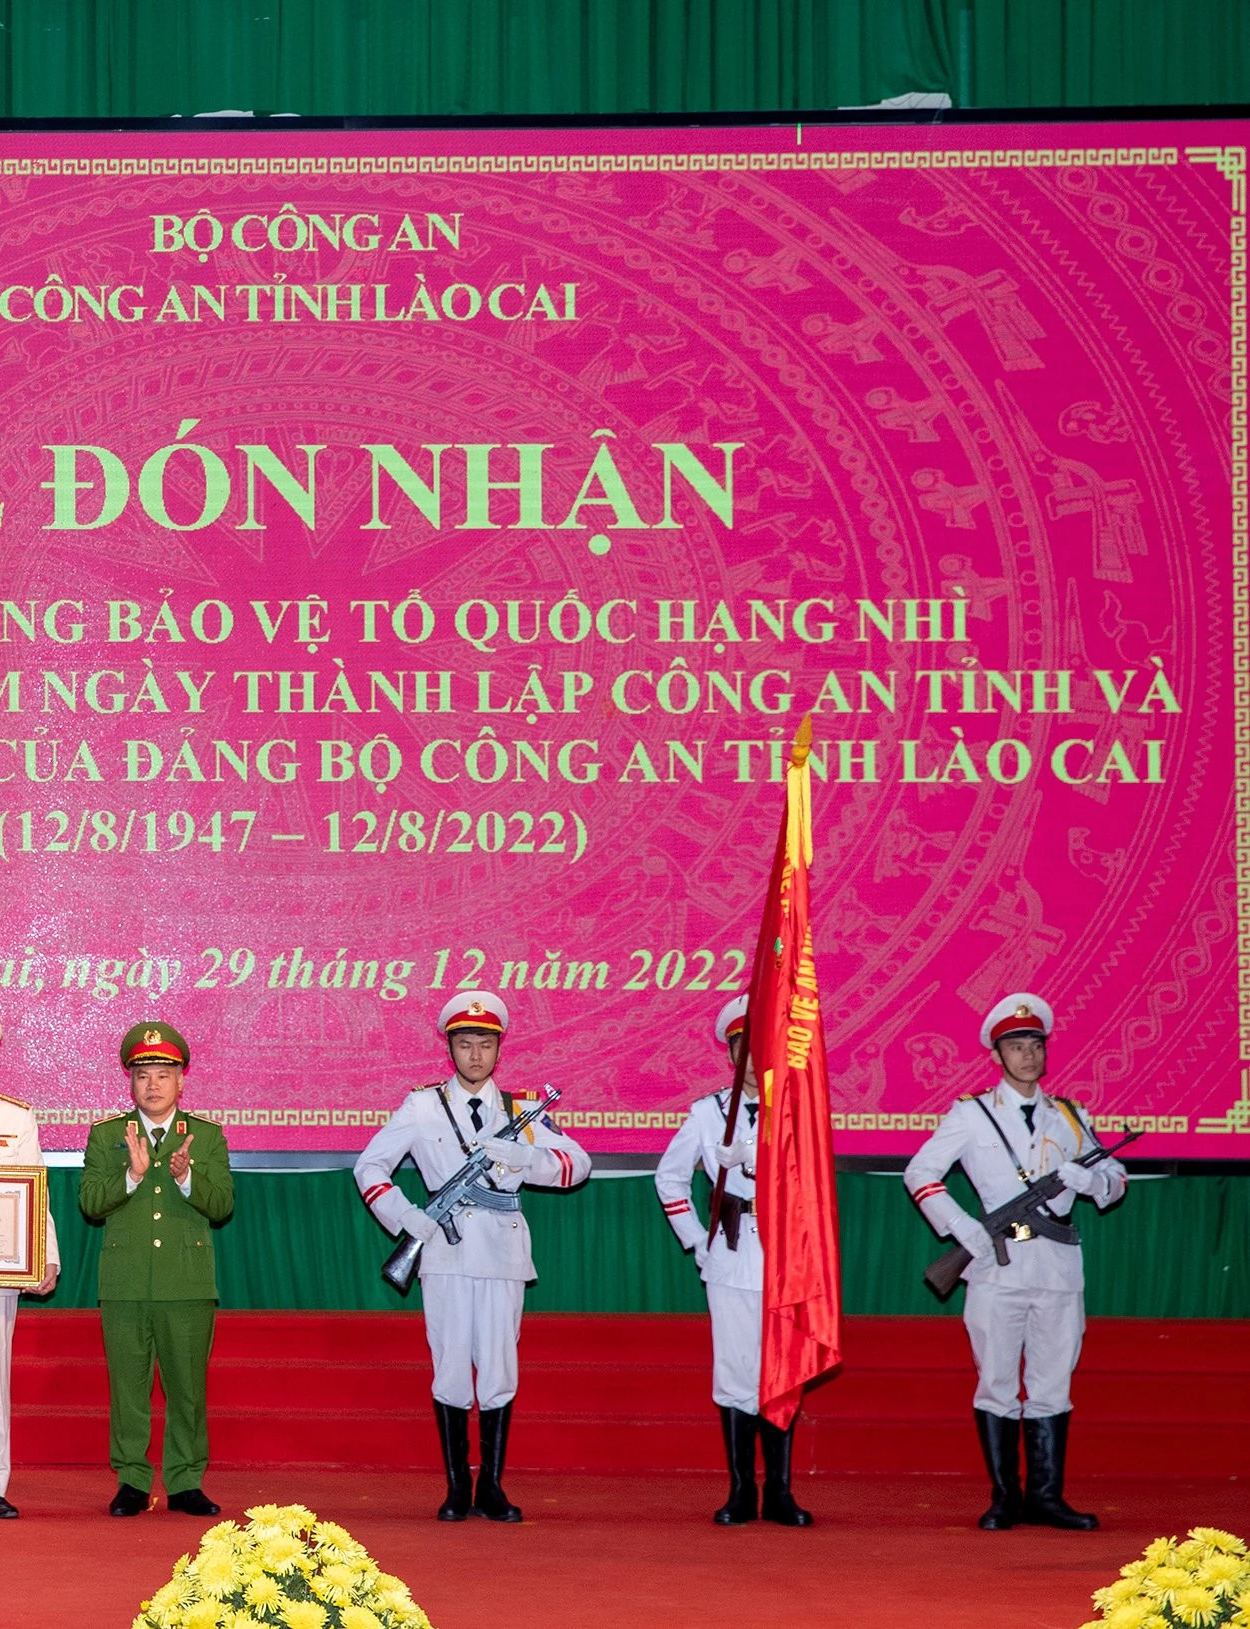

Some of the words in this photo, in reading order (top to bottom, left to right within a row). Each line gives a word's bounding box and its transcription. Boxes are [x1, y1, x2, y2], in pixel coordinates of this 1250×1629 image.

[151, 208, 225, 263] BỘ
[230, 202, 381, 252] CÔNG
[388, 213, 462, 251] AN
[155, 285, 227, 323] AN
[234, 272, 364, 322] TỈNH
[373, 273, 483, 322] LÀO
[487, 283, 577, 321] CAI
[39, 418, 328, 531] ĐÓN
[359, 428, 745, 556] NHẬN
[107, 587, 235, 644] BẢO
[250, 594, 330, 654] VỆ
[349, 586, 436, 644] TỔ
[453, 587, 638, 653] QUỐC
[656, 598, 836, 654] HẠNG
[857, 586, 969, 642] NHÌ
[41, 658, 216, 714] NGÀY
[233, 657, 454, 713] THÀNH
[475, 664, 595, 724] LẬP
[610, 656, 794, 715] CÔNG
[810, 670, 896, 713] AN
[914, 657, 1073, 713] TỈNH
[1093, 656, 1182, 713] VÀ
[123, 727, 300, 783] ĐẢNG
[319, 733, 404, 793] BỘ
[419, 726, 602, 784] CÔNG
[618, 740, 705, 783] AN
[900, 727, 1033, 784] LÀO
[1050, 739, 1164, 784] CAI
[326, 810, 589, 861] 12/8/2022)
[61, 948, 182, 1000] ngày
[194, 948, 256, 988] 29
[266, 947, 415, 1000] tháng
[429, 948, 488, 989] 12
[498, 951, 610, 990] năm
[622, 949, 747, 991] 2022
